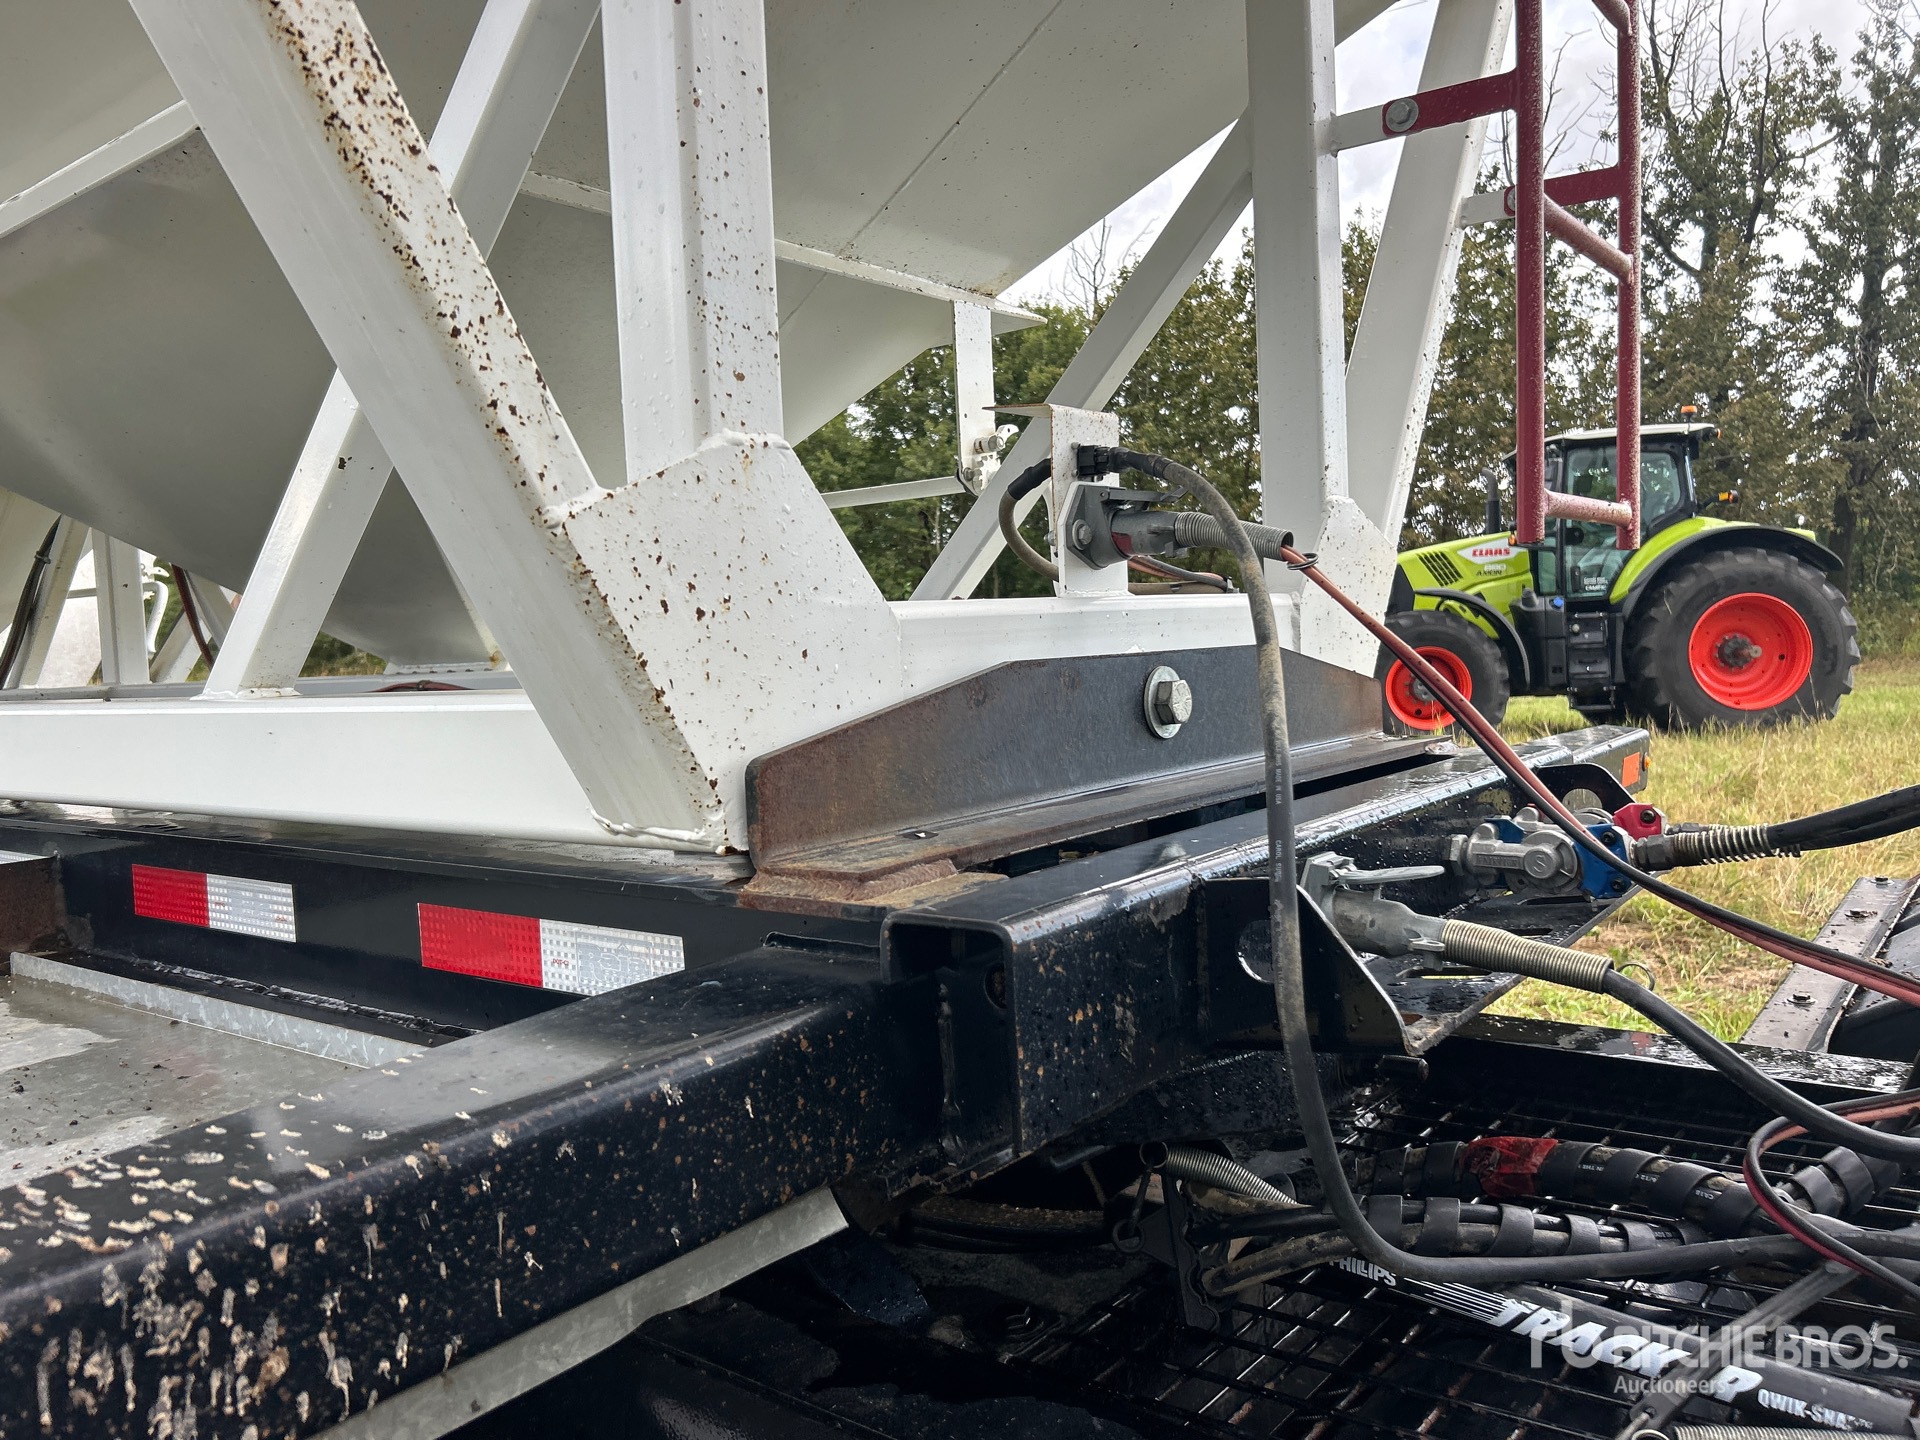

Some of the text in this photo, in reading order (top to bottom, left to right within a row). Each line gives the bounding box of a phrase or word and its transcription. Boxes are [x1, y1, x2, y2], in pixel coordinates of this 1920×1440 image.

[1472, 548, 1510, 557] CLAAS
[1329, 1256, 1396, 1287] HILLIPS
[1490, 1298, 1763, 1403] TRACKR
